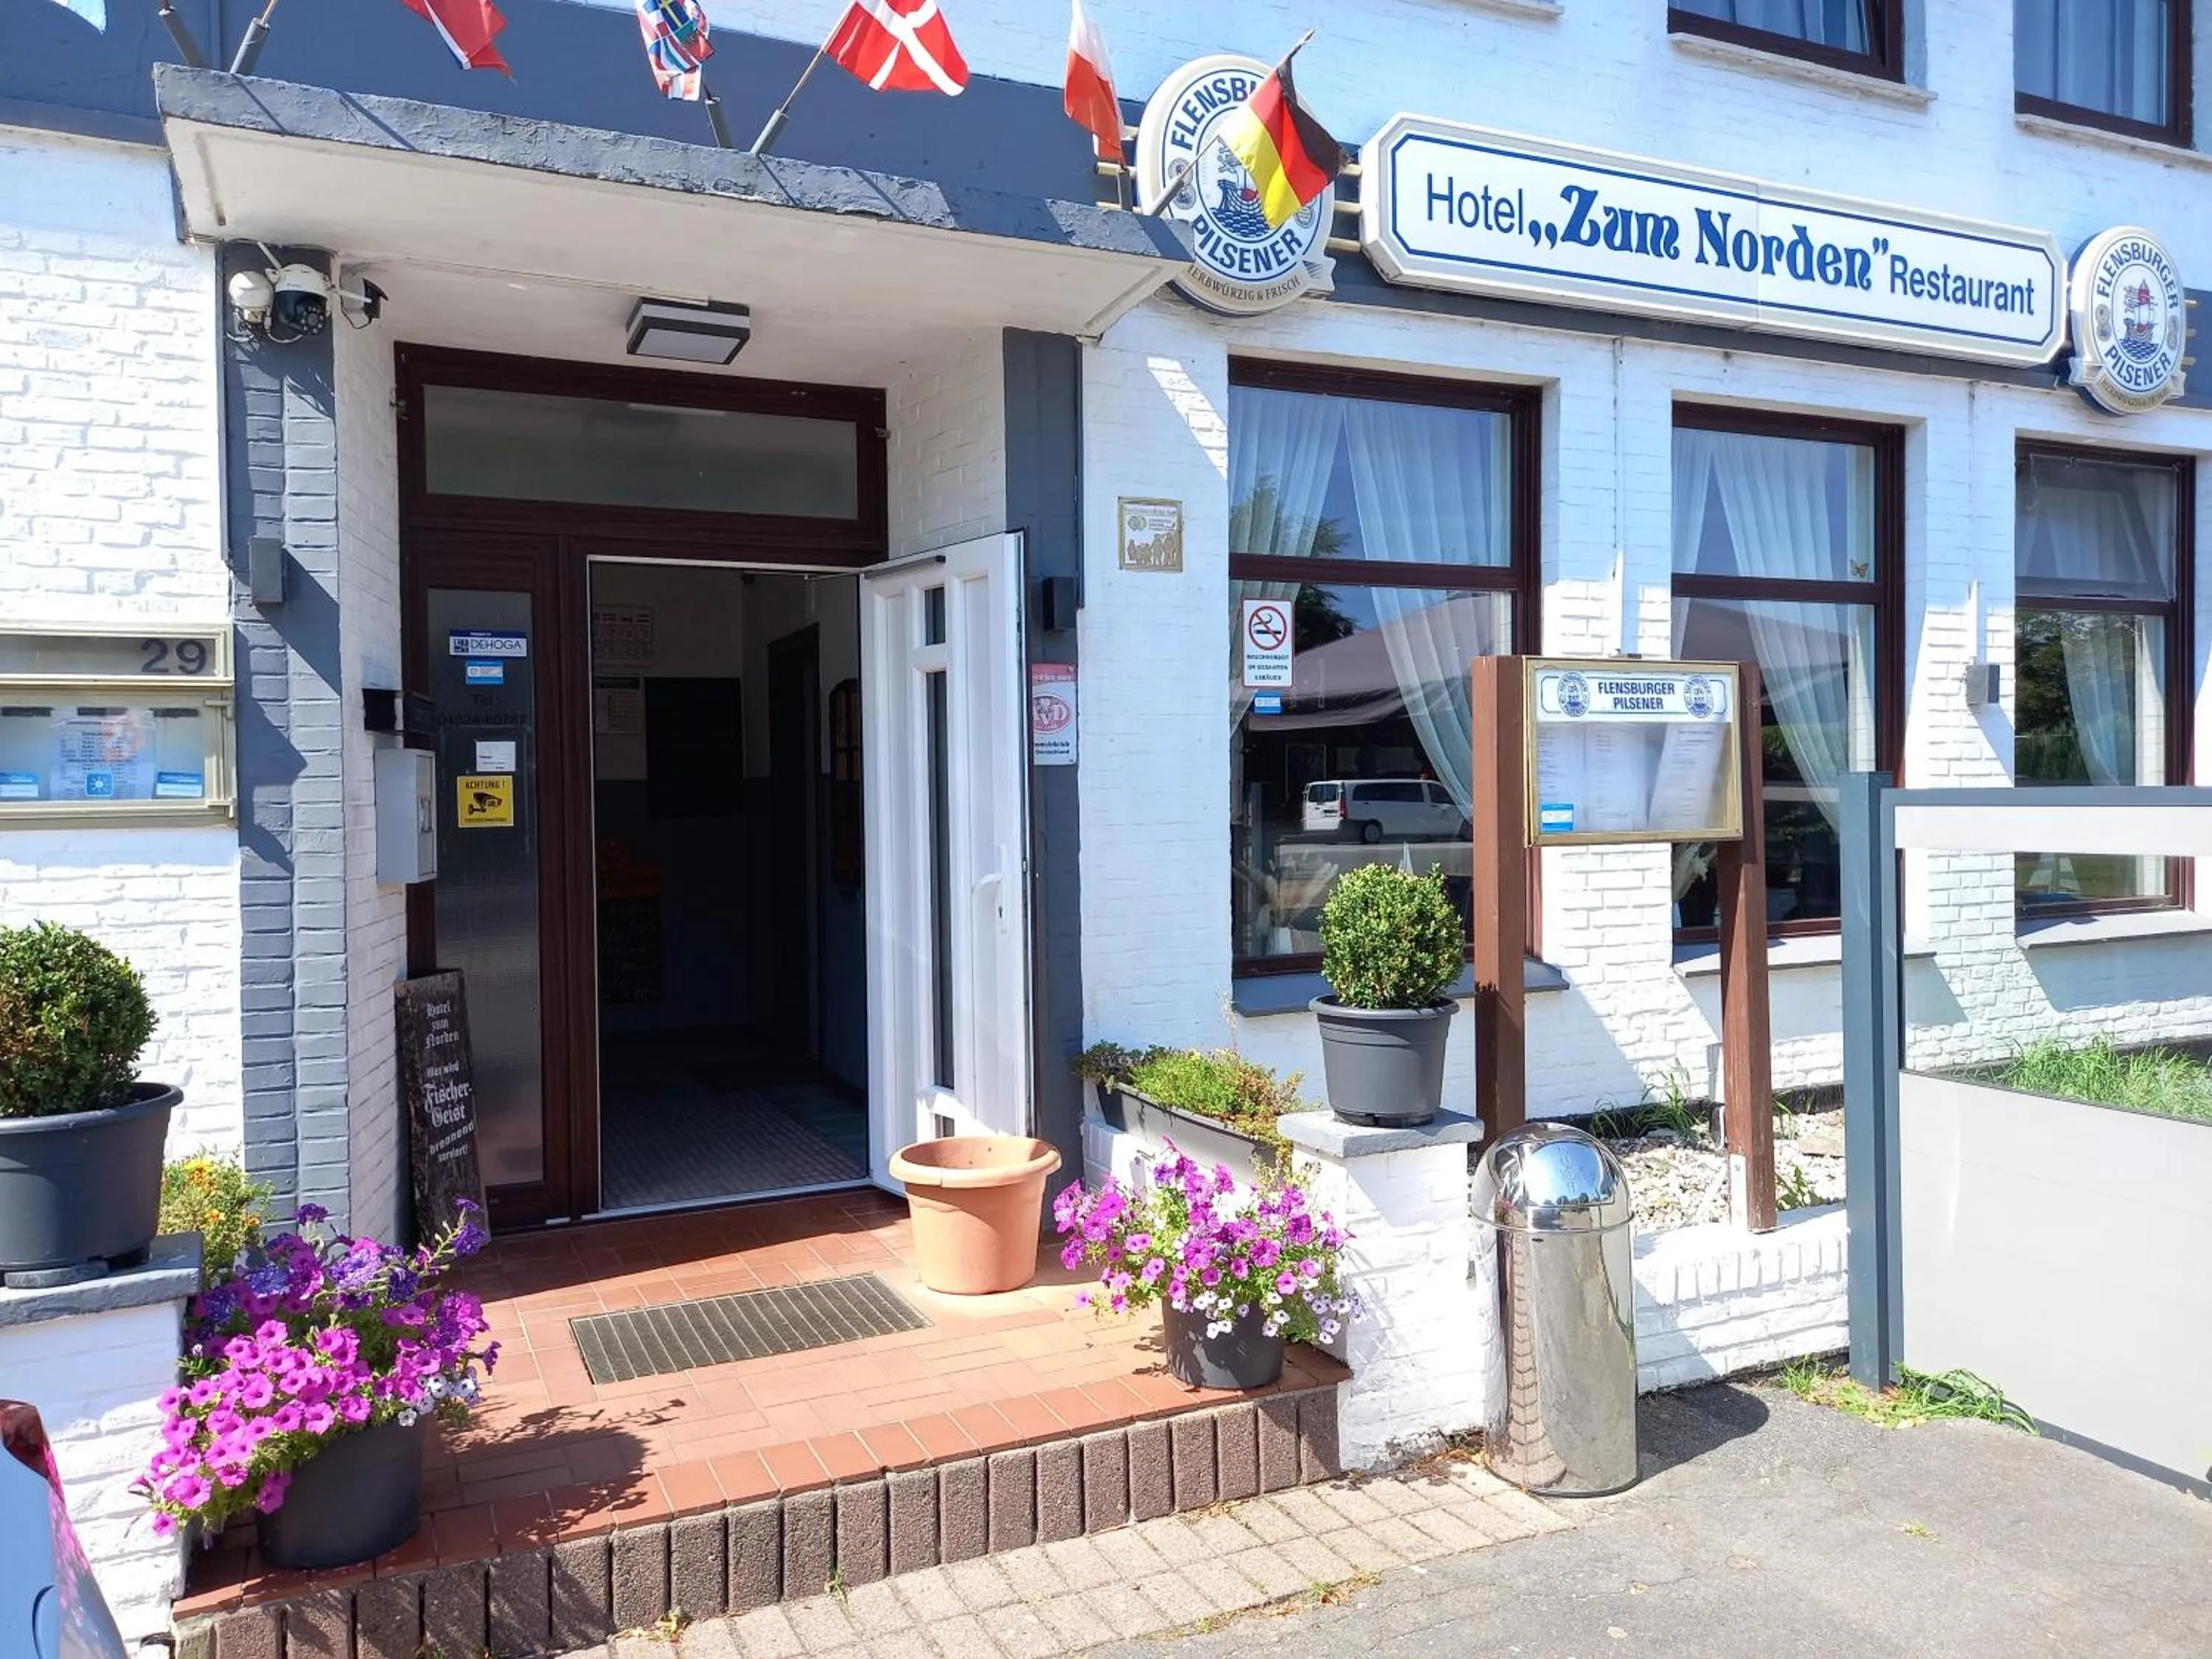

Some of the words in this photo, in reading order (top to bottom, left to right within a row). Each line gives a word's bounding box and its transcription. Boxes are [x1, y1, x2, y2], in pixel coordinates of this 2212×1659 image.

[1192, 214, 1304, 274] PILSENER
[1427, 172, 1523, 235] Hotel
[1889, 254, 2035, 316] Restaurant
[1265, 274, 1301, 299] FRISCH
[2097, 242, 2179, 310] FLENSBURGER
[2104, 344, 2171, 386] PILSENER
[140, 638, 207, 675] 29
[470, 639, 521, 650] DEHOGA
[1598, 682, 1675, 695] FLENSBURGER
[1613, 697, 1664, 710] PILSENER
[424, 1078, 473, 1113] Fischer-
[431, 1102, 465, 1127] Geist
[429, 1119, 474, 1155] brennend
